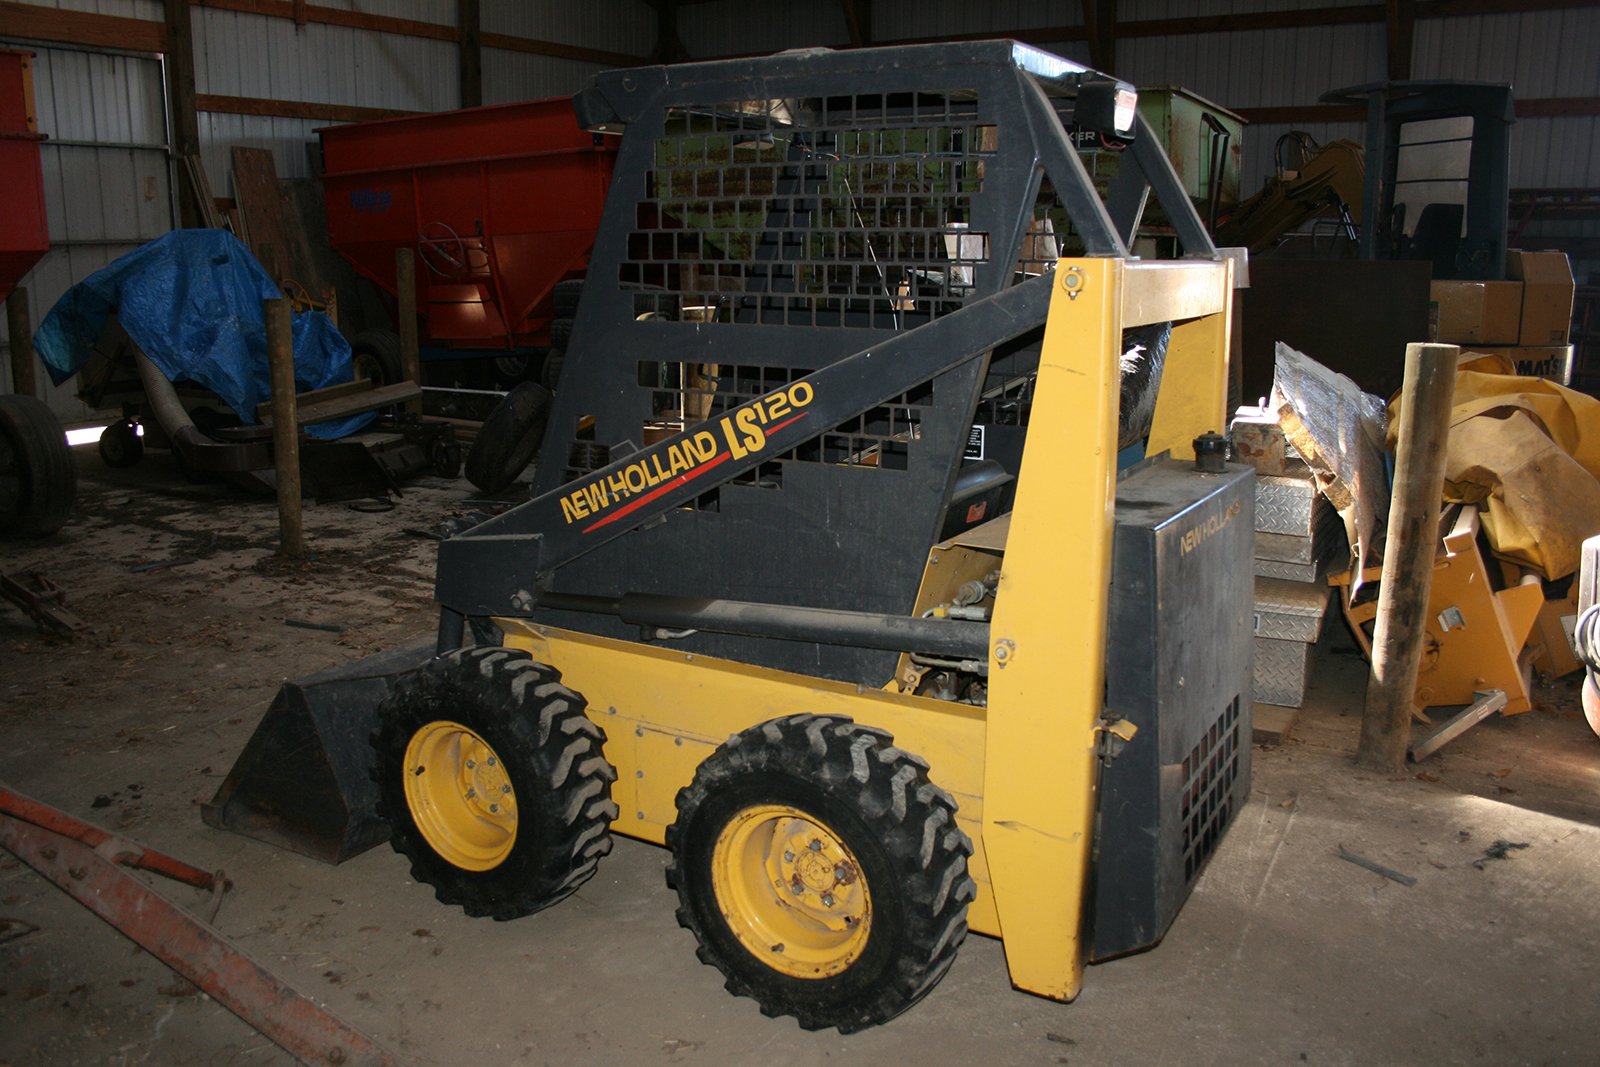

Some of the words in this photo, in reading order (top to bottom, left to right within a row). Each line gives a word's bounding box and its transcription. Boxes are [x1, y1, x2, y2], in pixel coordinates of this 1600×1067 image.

[559, 478, 611, 524] NEW
[607, 430, 718, 503] HOLLAND
[1180, 524, 1202, 557] NEW
